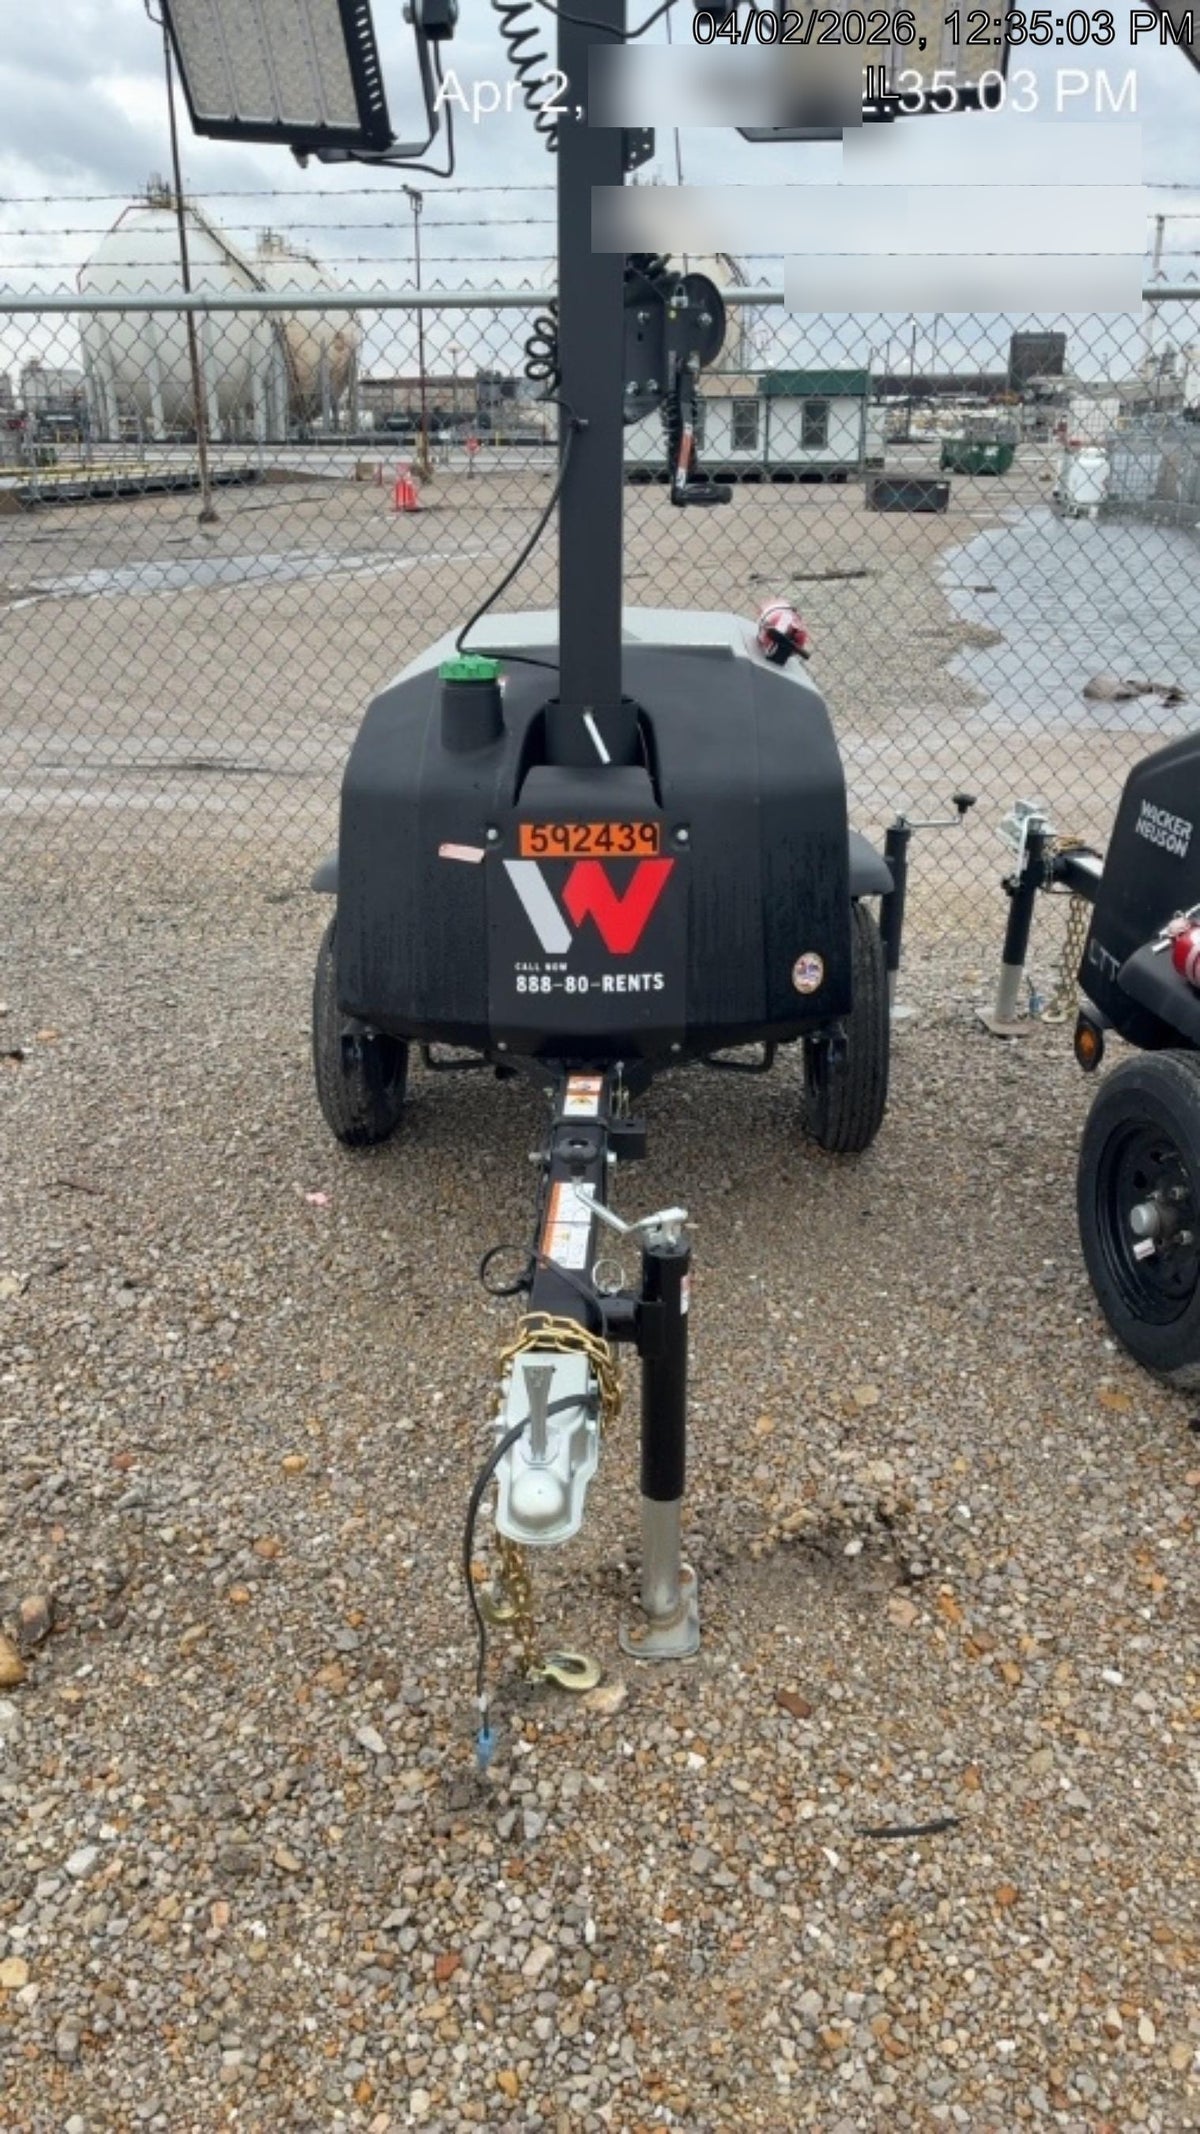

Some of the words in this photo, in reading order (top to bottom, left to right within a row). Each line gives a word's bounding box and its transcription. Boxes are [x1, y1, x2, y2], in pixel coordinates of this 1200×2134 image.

[1142, 799, 1193, 840] WACKER
[529, 824, 659, 854] 592439
[1135, 817, 1190, 858] NEUSON
[513, 961, 540, 972] CALL
[544, 961, 568, 972] NOW
[516, 972, 665, 994] 888-80-RENTS
